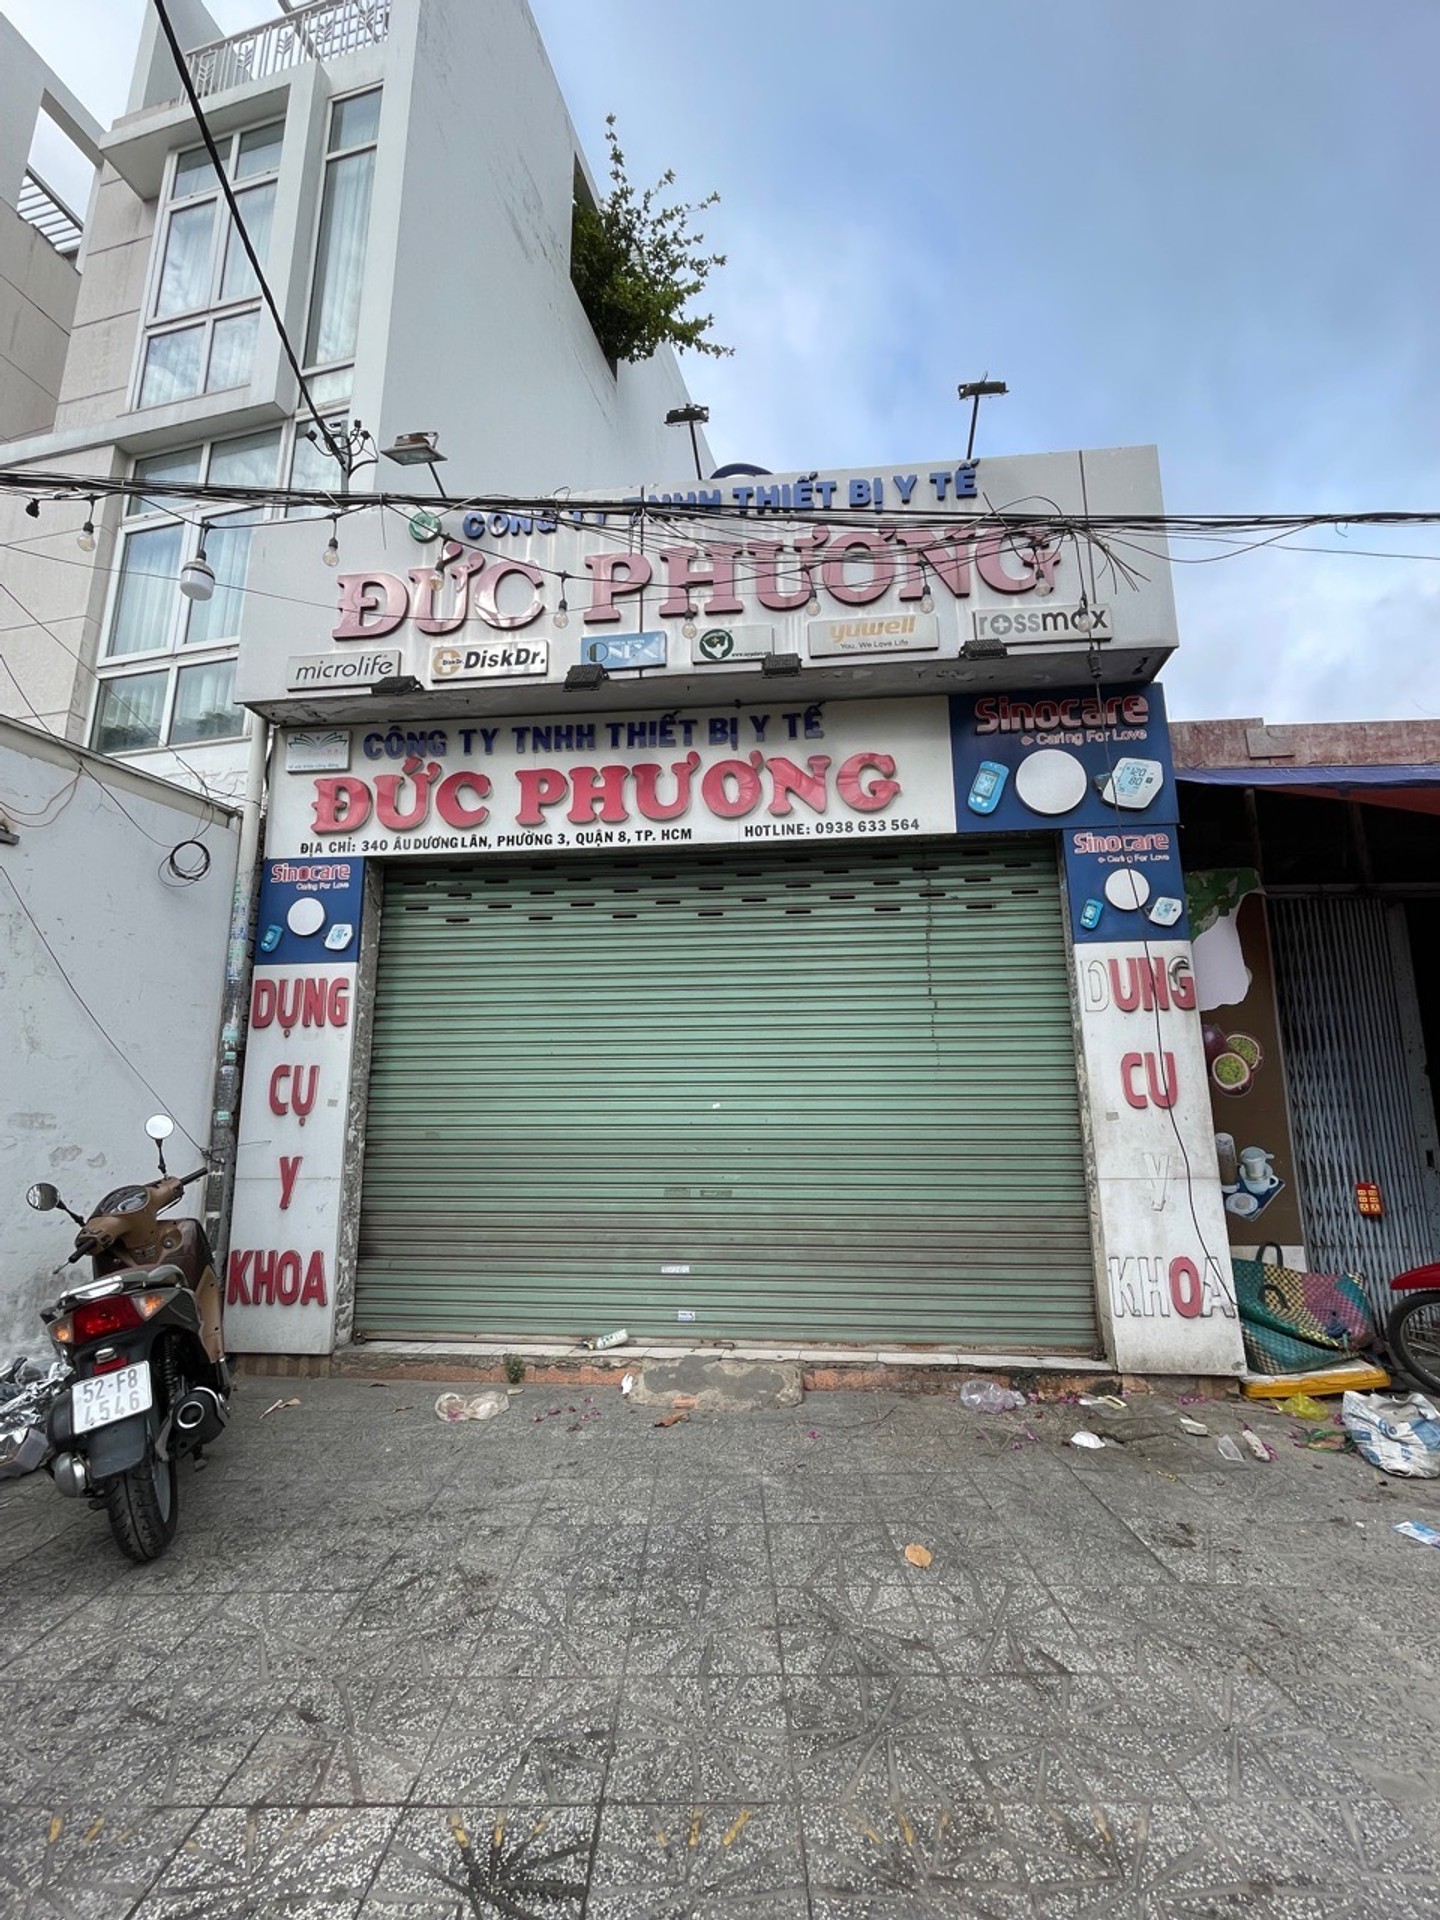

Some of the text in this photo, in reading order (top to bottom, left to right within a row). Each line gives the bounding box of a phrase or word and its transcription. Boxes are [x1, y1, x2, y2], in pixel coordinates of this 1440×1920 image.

[733, 472, 836, 514] THIẾT
[849, 477, 883, 513] BỊ
[893, 474, 917, 504] Y
[929, 458, 980, 500] TẾ
[332, 523, 1060, 639] ĐỨC PHƯƠNG
[829, 615, 916, 643] yuwell
[295, 653, 394, 681] microlife
[464, 649, 546, 671] DiskDr.
[363, 702, 826, 758] CÔNG TY TNHH THIẾT BỊ Y TẾ
[975, 695, 1149, 734] Sinocare
[1036, 728, 1148, 746] Caring For Love
[310, 750, 901, 834] ĐỨC PHƯƠNG
[300, 841, 323, 857] ĐỊA
[328, 836, 356, 853] CHỈ:
[361, 840, 388, 852] 340
[497, 829, 553, 846] PHƯỜNG
[557, 832, 571, 846] 3,
[576, 828, 614, 847] QUẬN
[618, 831, 631, 844] 8,
[635, 830, 656, 842] TP.
[661, 828, 692, 841] HCM
[744, 823, 811, 837] HOTLINE:
[815, 821, 854, 834] 0938
[857, 820, 886, 833] 633
[891, 819, 920, 832] 564
[1073, 832, 1169, 854] Sinocare
[270, 863, 350, 883] Sinocare
[1134, 854, 1148, 862] For
[1150, 853, 1170, 861] Love
[319, 882, 331, 890] For
[332, 881, 350, 889] Love
[251, 977, 349, 1038] DỤNG
[269, 1064, 320, 1126] CỤ
[279, 1156, 303, 1210] Y
[1142, 1152, 1173, 1211] Y
[227, 1249, 328, 1306] KHOA
[1108, 1255, 1236, 1319] KHOA
[83, 1368, 138, 1403] 52-F8
[84, 1391, 140, 1426] 4546
